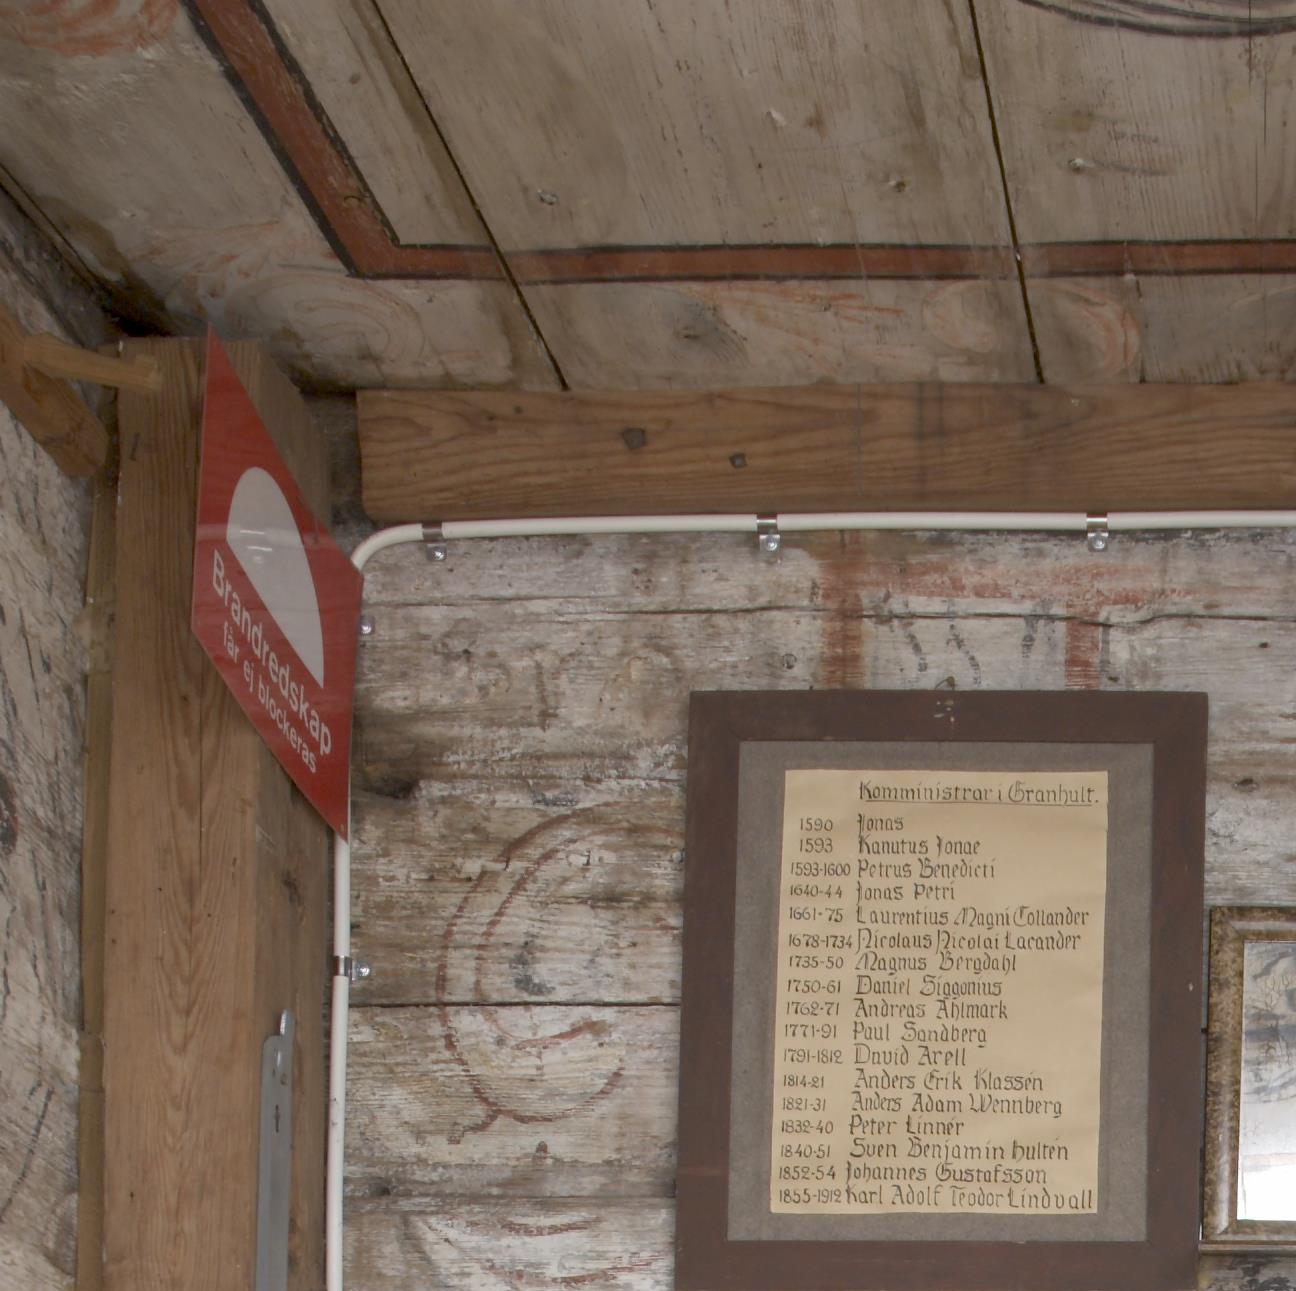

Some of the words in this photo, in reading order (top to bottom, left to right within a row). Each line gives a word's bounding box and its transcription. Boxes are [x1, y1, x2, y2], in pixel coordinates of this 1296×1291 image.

[213, 549, 332, 755] Brandredskap
[223, 621, 240, 663] får
[243, 660, 255, 692] ej
[258, 678, 317, 774] blockeras
[859, 781, 992, 801] Komministrar
[997, 781, 1003, 801] i
[800, 819, 833, 831] 1590
[858, 814, 904, 836] Jonas
[800, 839, 833, 852] 1593
[858, 836, 928, 855] Kanutus
[791, 862, 850, 876] 1593-1600
[858, 861, 912, 878] Petrus
[919, 858, 996, 879] Benedicti
[790, 886, 842, 898] 1640-44
[857, 881, 903, 904] Jonas
[914, 881, 955, 899] Petri
[789, 908, 843, 923] 1661-75
[856, 906, 949, 924] Laurentius
[954, 907, 1009, 929] Magni
[789, 934, 852, 948] 1678-1734
[857, 929, 932, 951] Nicolaus
[789, 956, 843, 969] 1735-50
[854, 952, 927, 976] Magnus
[788, 980, 841, 993] 1750-61
[856, 975, 910, 996] Daniel
[786, 1002, 839, 1016] 1762-71
[854, 999, 925, 1019] Andreas
[937, 999, 1008, 1021] Ahlmark
[785, 1024, 836, 1039] 1771-91
[853, 1021, 889, 1041] Paul
[901, 1022, 987, 1048] Sandberg
[784, 1049, 842, 1064] 1791-1812
[854, 1044, 909, 1065] David
[918, 1046, 965, 1066] Arell
[784, 1075, 824, 1088] 1814-21
[854, 1069, 914, 1089] Anders
[924, 1072, 961, 1091] Erik
[782, 1098, 826, 1111] 1821-31
[852, 1092, 902, 1111] Anders
[912, 1094, 962, 1113] Adam
[970, 1093, 1062, 1118] Wennberg
[781, 1119, 833, 1134] 1832-40
[849, 1114, 896, 1135] Peter
[781, 1144, 830, 1158] 1840-51
[849, 1138, 896, 1158] Sven
[908, 1138, 1004, 1162] Benjamin
[779, 1165, 836, 1180] 1852-54
[846, 1161, 926, 1184] Johannes
[936, 1163, 1046, 1184] Gustafsson
[779, 1189, 842, 1203] 1855-1912
[845, 1184, 882, 1204] Karl
[892, 1185, 940, 1206] Adolf
[950, 1186, 1004, 1208] Teodor
[1008, 1187, 1092, 1209] Lindvall
